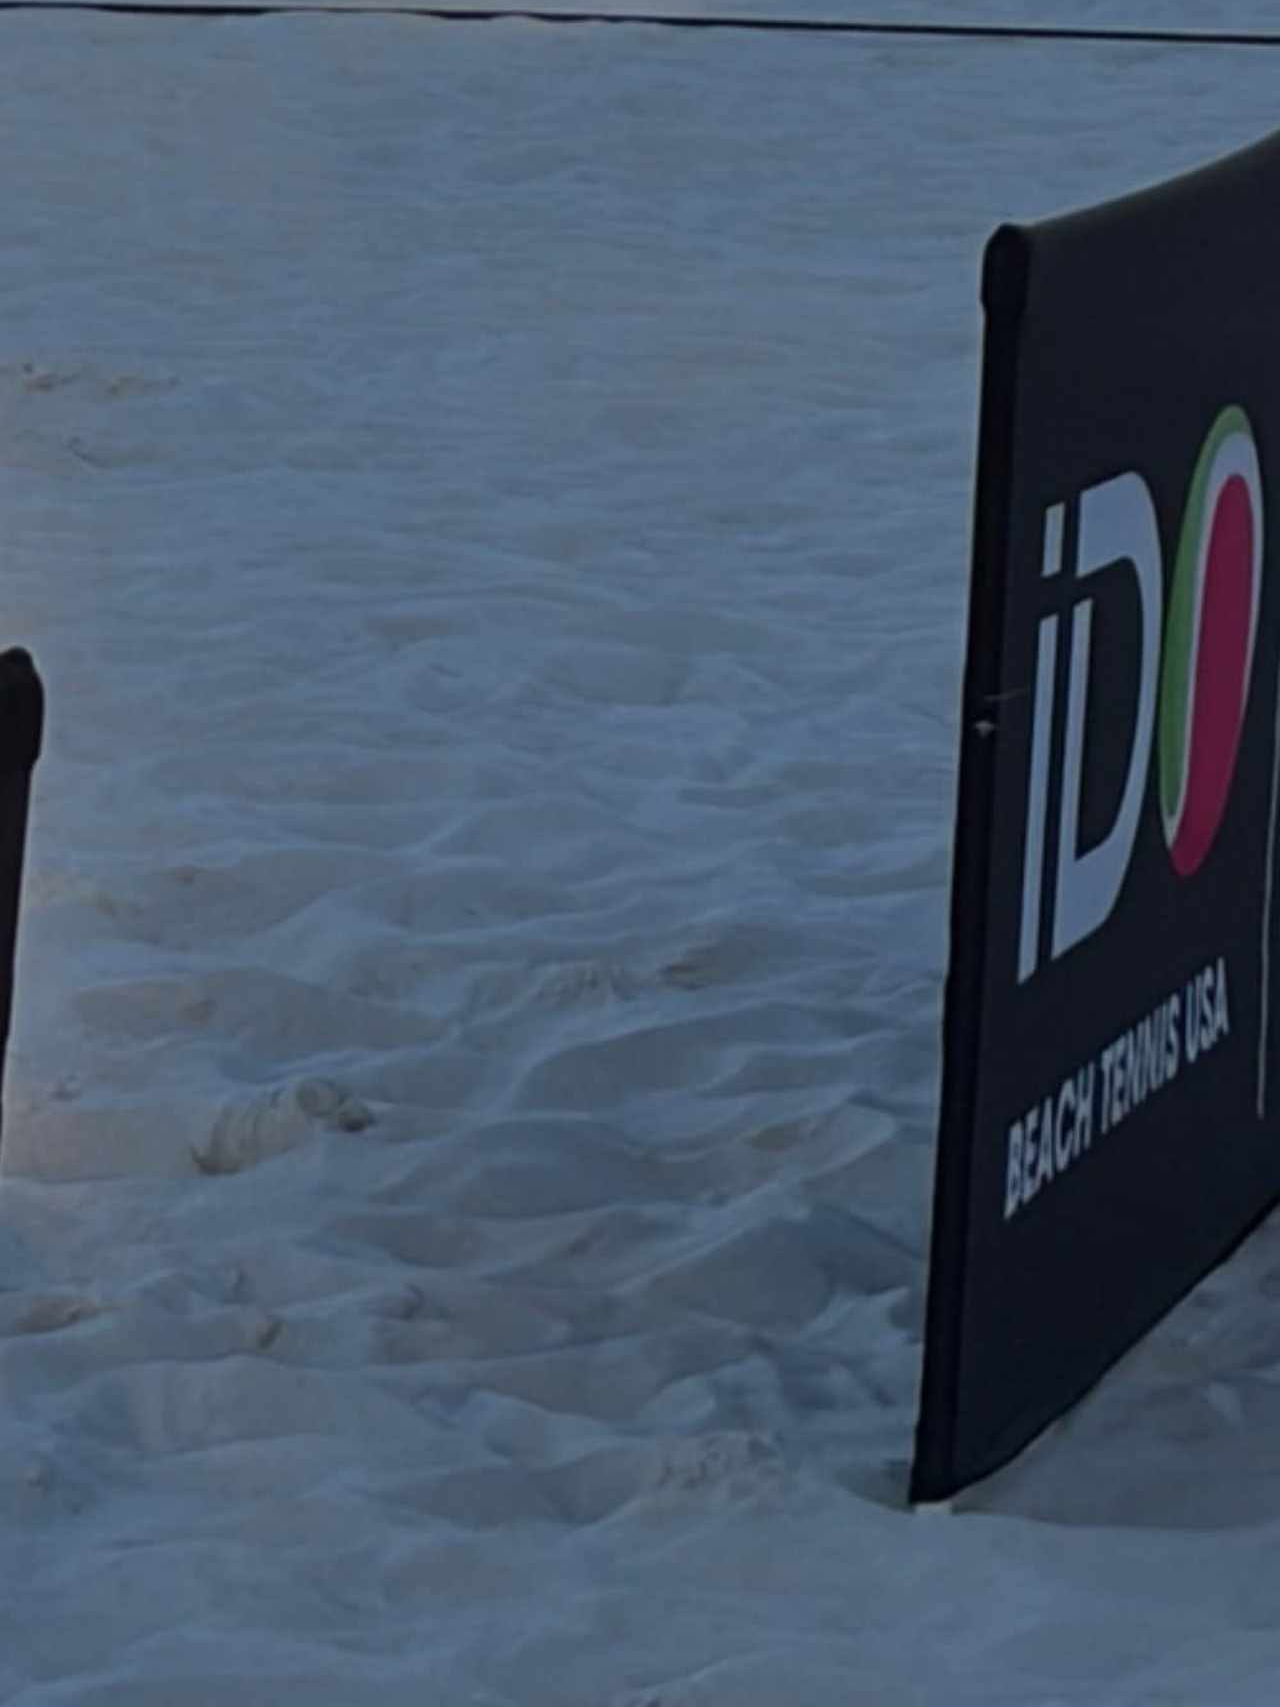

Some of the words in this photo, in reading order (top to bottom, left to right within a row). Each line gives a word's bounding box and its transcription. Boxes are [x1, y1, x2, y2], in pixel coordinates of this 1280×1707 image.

[1004, 1062, 1095, 1220] BEACH
[1101, 993, 1181, 1134] TENNIS
[1185, 956, 1229, 1063] USA
